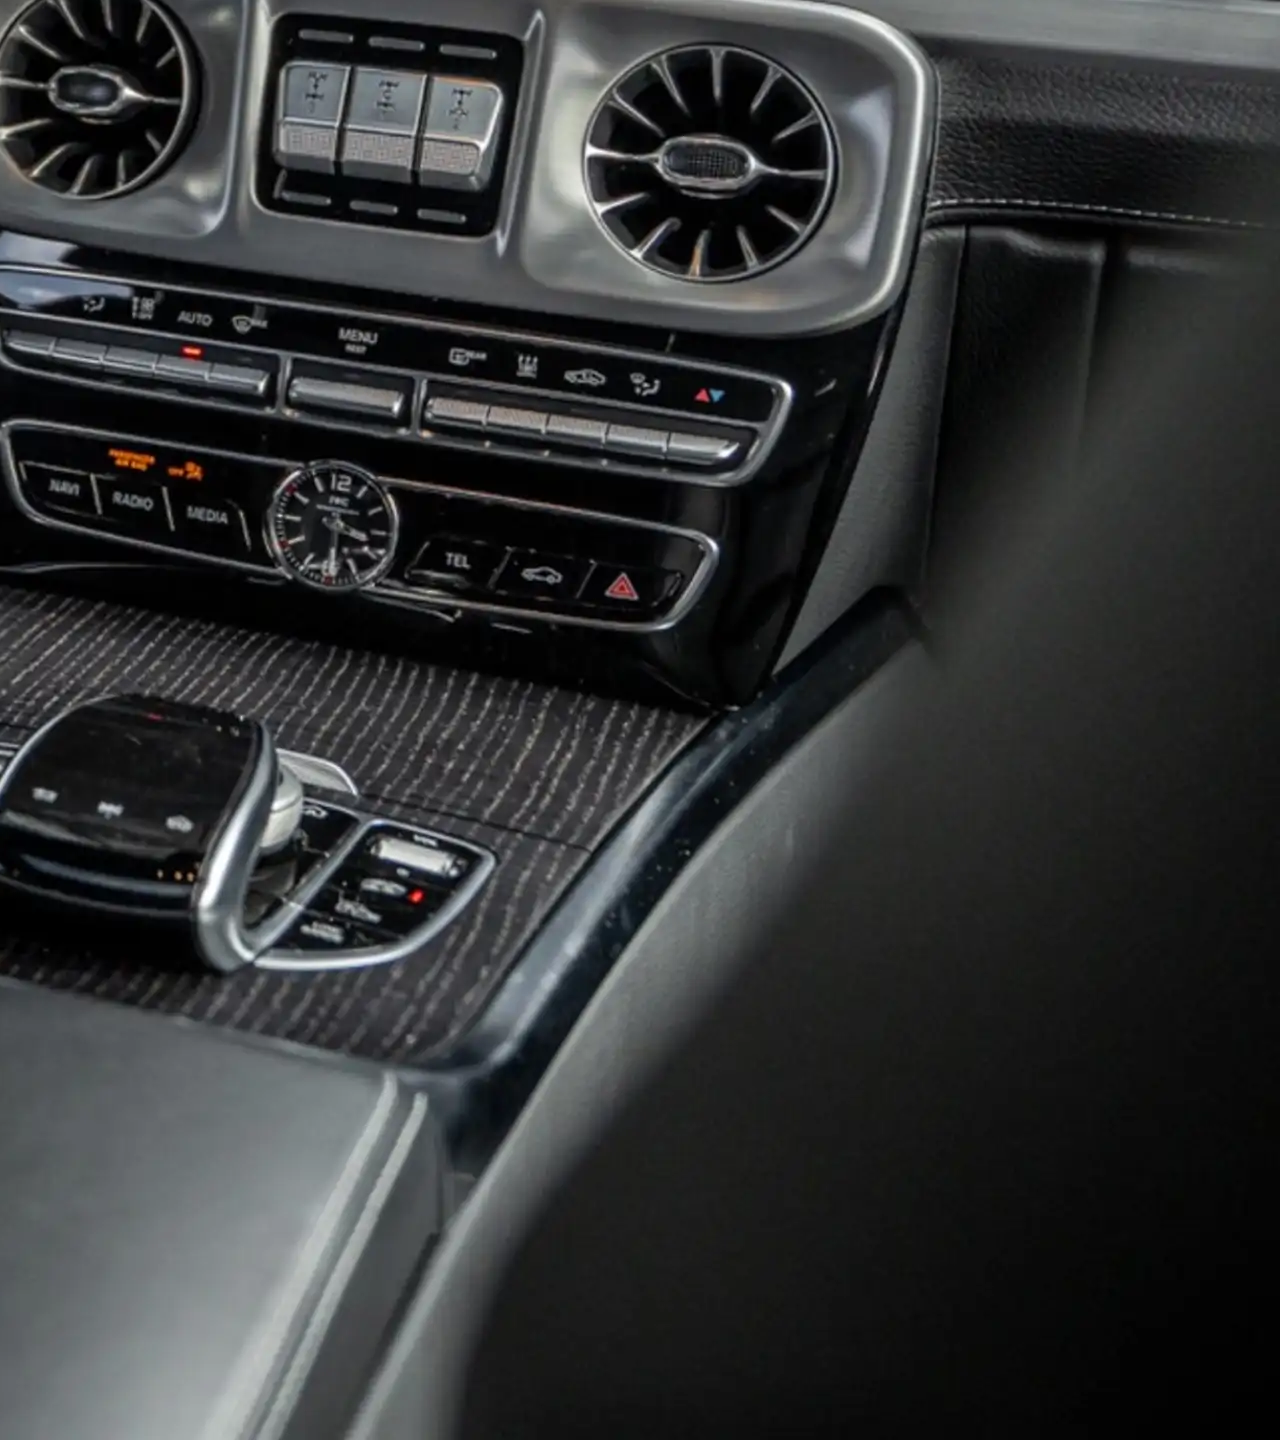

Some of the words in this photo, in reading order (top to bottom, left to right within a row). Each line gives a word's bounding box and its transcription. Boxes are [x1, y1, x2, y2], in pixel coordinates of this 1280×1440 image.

[177, 310, 213, 328] AUTO
[338, 327, 379, 346] MENU
[48, 477, 81, 497] NAVI
[331, 472, 352, 492] 12
[112, 490, 154, 512] RADIO
[186, 504, 229, 525] MEDIA
[445, 551, 472, 570] TEL
